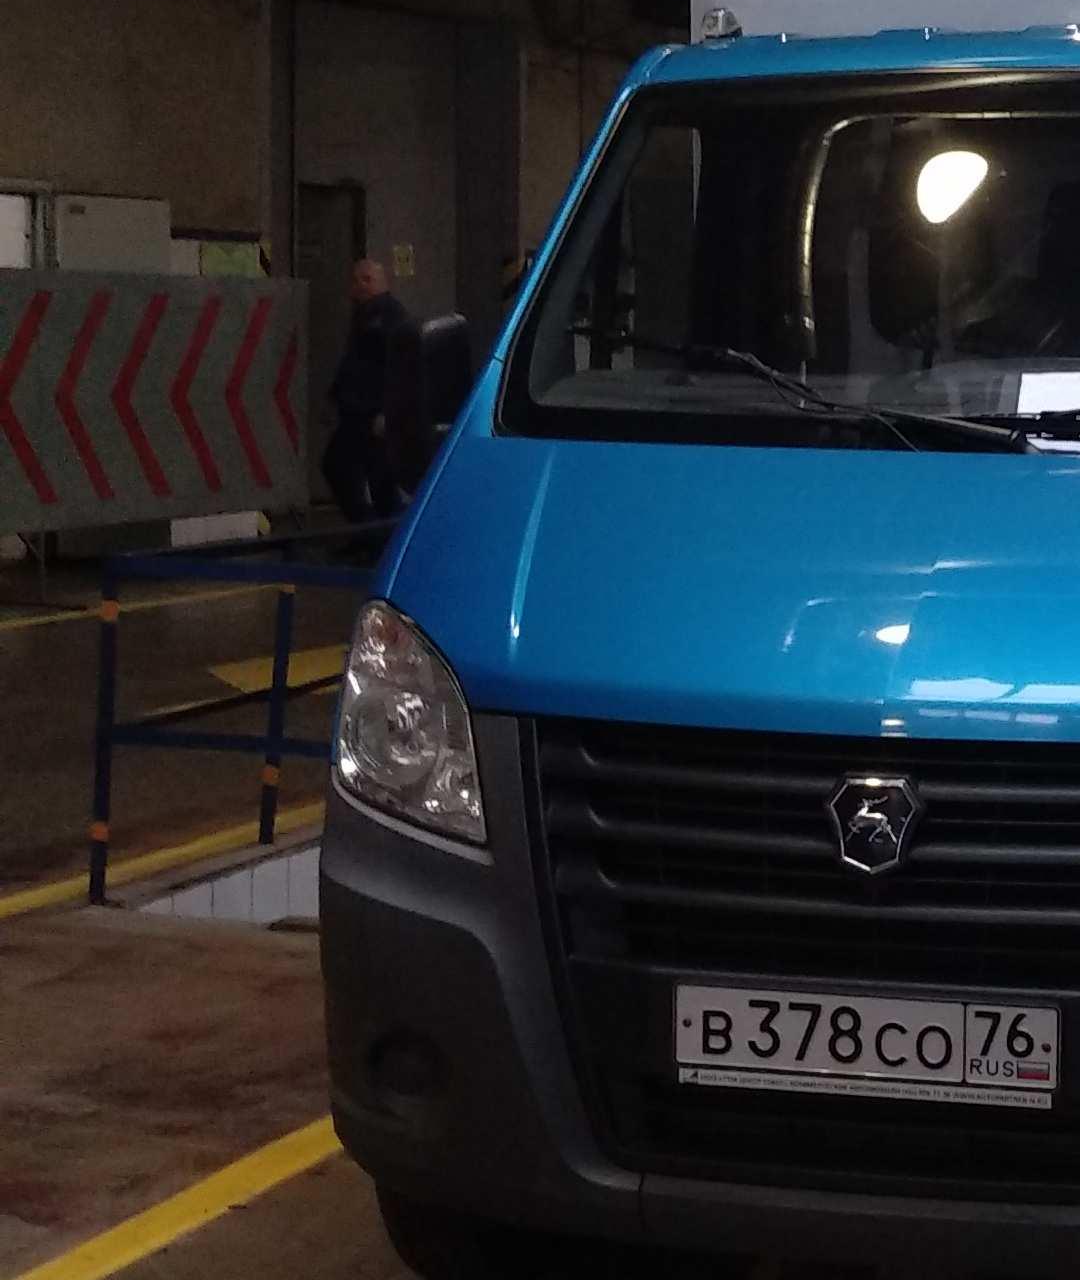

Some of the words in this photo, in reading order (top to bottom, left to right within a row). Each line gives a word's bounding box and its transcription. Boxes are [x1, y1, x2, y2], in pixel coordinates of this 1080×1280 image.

[701, 999, 952, 1070] В378СО
[974, 1011, 1034, 1058] 76
[969, 1059, 1014, 1077] RUS
